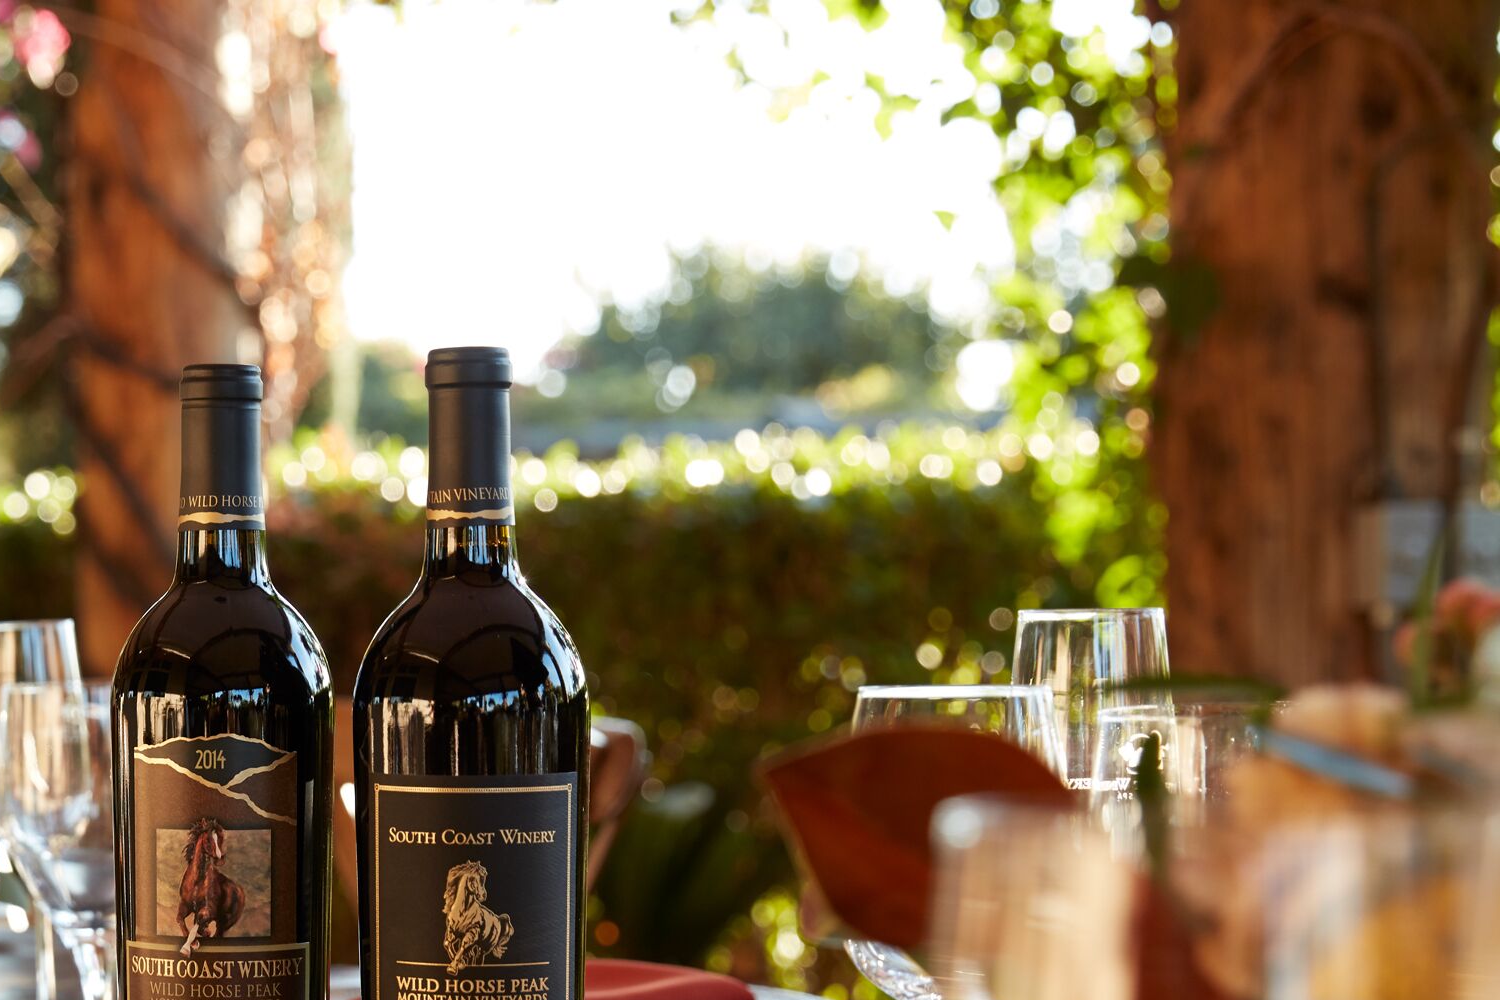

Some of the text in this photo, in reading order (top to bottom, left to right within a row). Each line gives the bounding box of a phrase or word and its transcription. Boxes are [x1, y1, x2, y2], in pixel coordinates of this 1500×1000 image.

[188, 495, 218, 508] WILD
[222, 495, 258, 508] HORSE
[429, 489, 451, 504] TAIN
[195, 750, 226, 770] 2014
[389, 827, 557, 846] SOUTH COAST WINERY
[132, 955, 303, 979] SOUTH COAST WINERY
[150, 981, 282, 998] WILD HORSE PEAK
[396, 976, 550, 994] WILD HORSE PEAK
